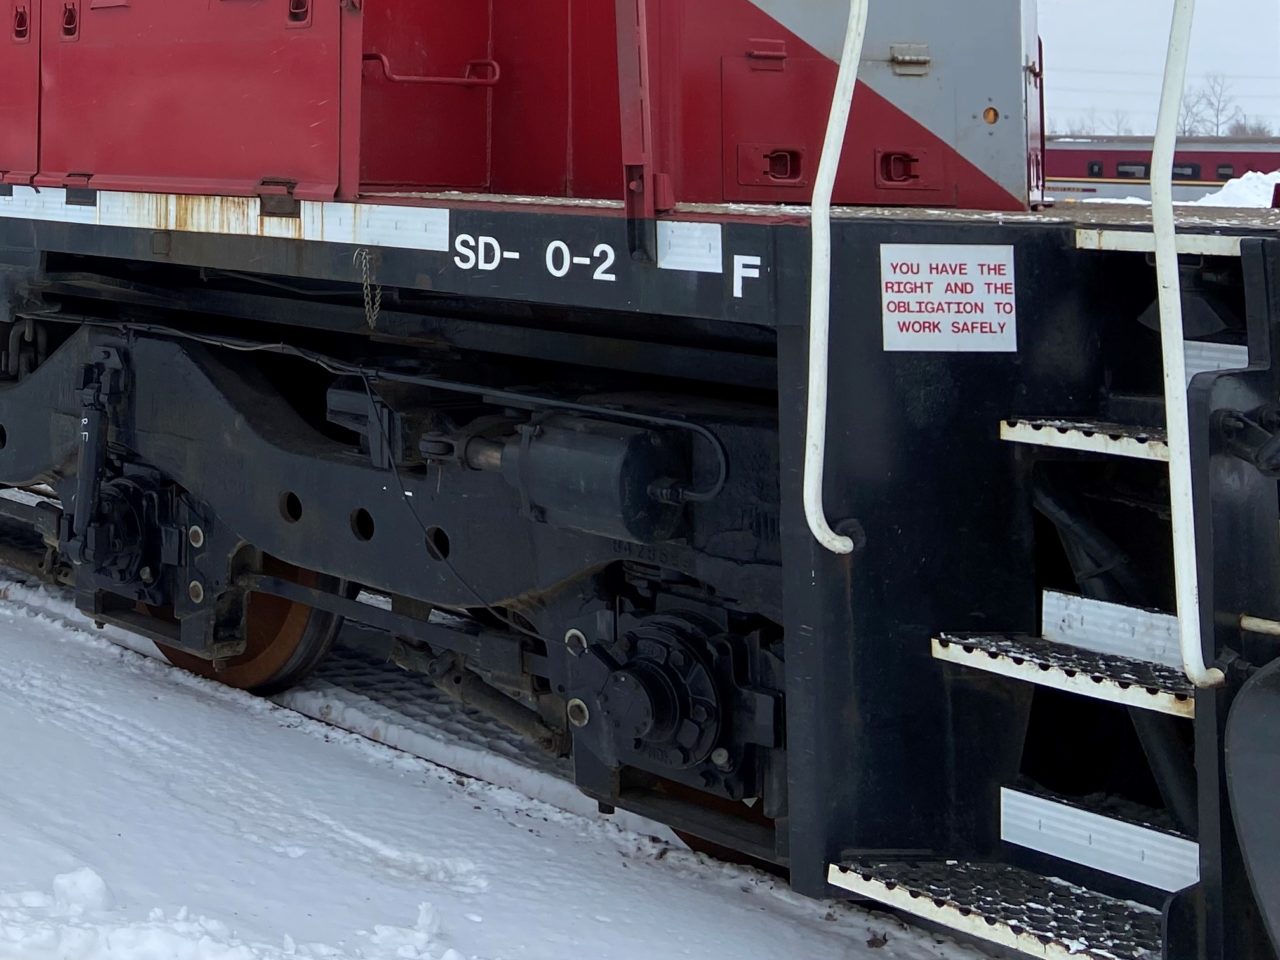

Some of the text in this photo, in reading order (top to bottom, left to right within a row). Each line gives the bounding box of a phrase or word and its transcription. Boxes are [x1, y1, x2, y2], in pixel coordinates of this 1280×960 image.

[733, 254, 761, 297] F
[890, 262, 1007, 276] YOU HAVE THE
[885, 281, 1013, 295] RIGHT AND THE
[886, 301, 1013, 315] OBLIGATION TO
[897, 321, 1006, 334] WORK SAFELY
